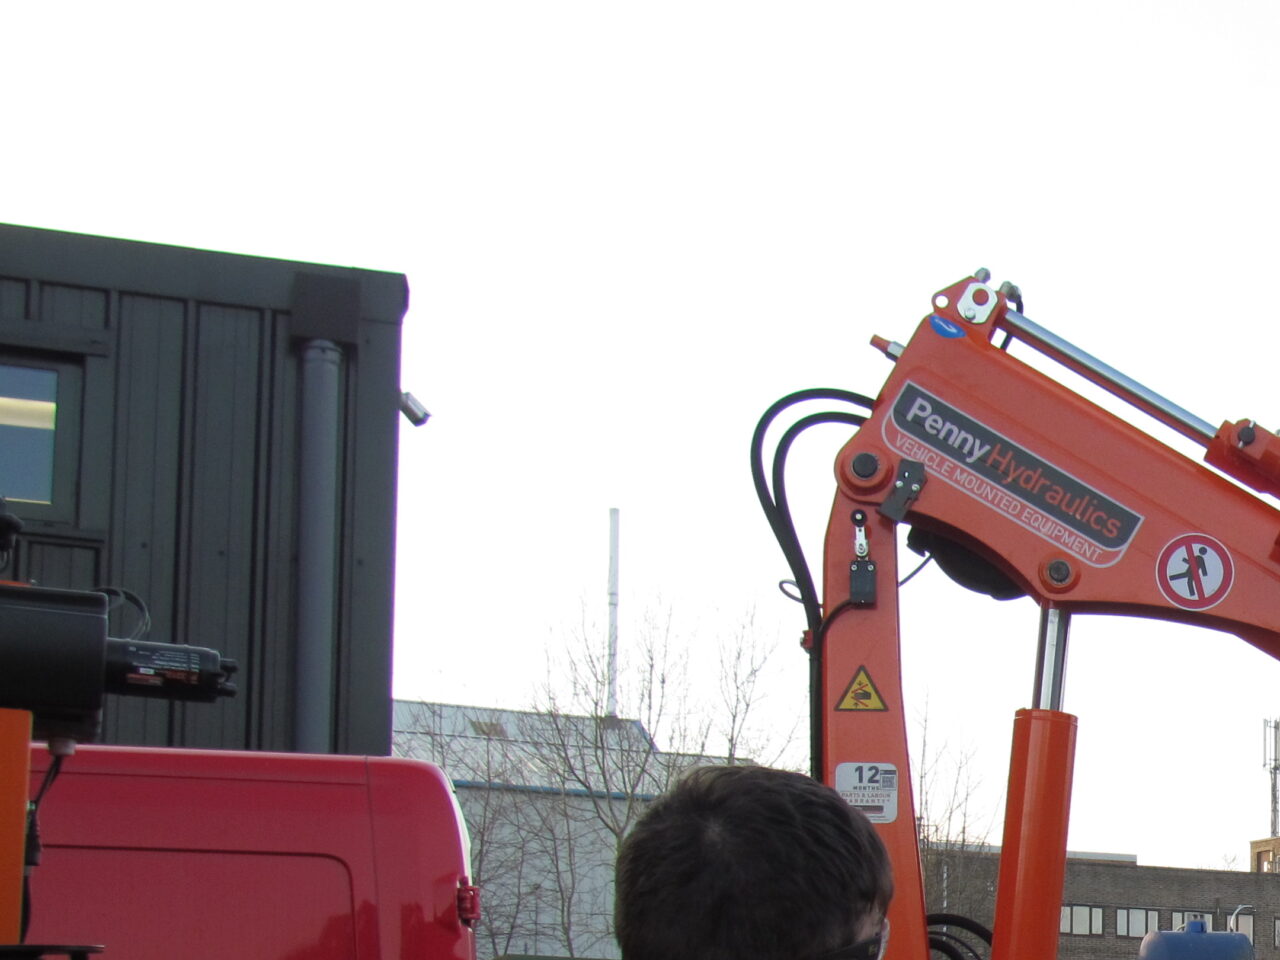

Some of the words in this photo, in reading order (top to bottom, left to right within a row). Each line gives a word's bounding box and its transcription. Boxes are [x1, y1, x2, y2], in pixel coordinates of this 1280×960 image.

[895, 434, 954, 475] VEHICLE
[953, 465, 1022, 516] MOUNTED
[1020, 504, 1104, 562] EQUIPMENT
[905, 397, 990, 463] Penny
[985, 443, 1122, 539] Hydraulics
[854, 765, 880, 784] 12
